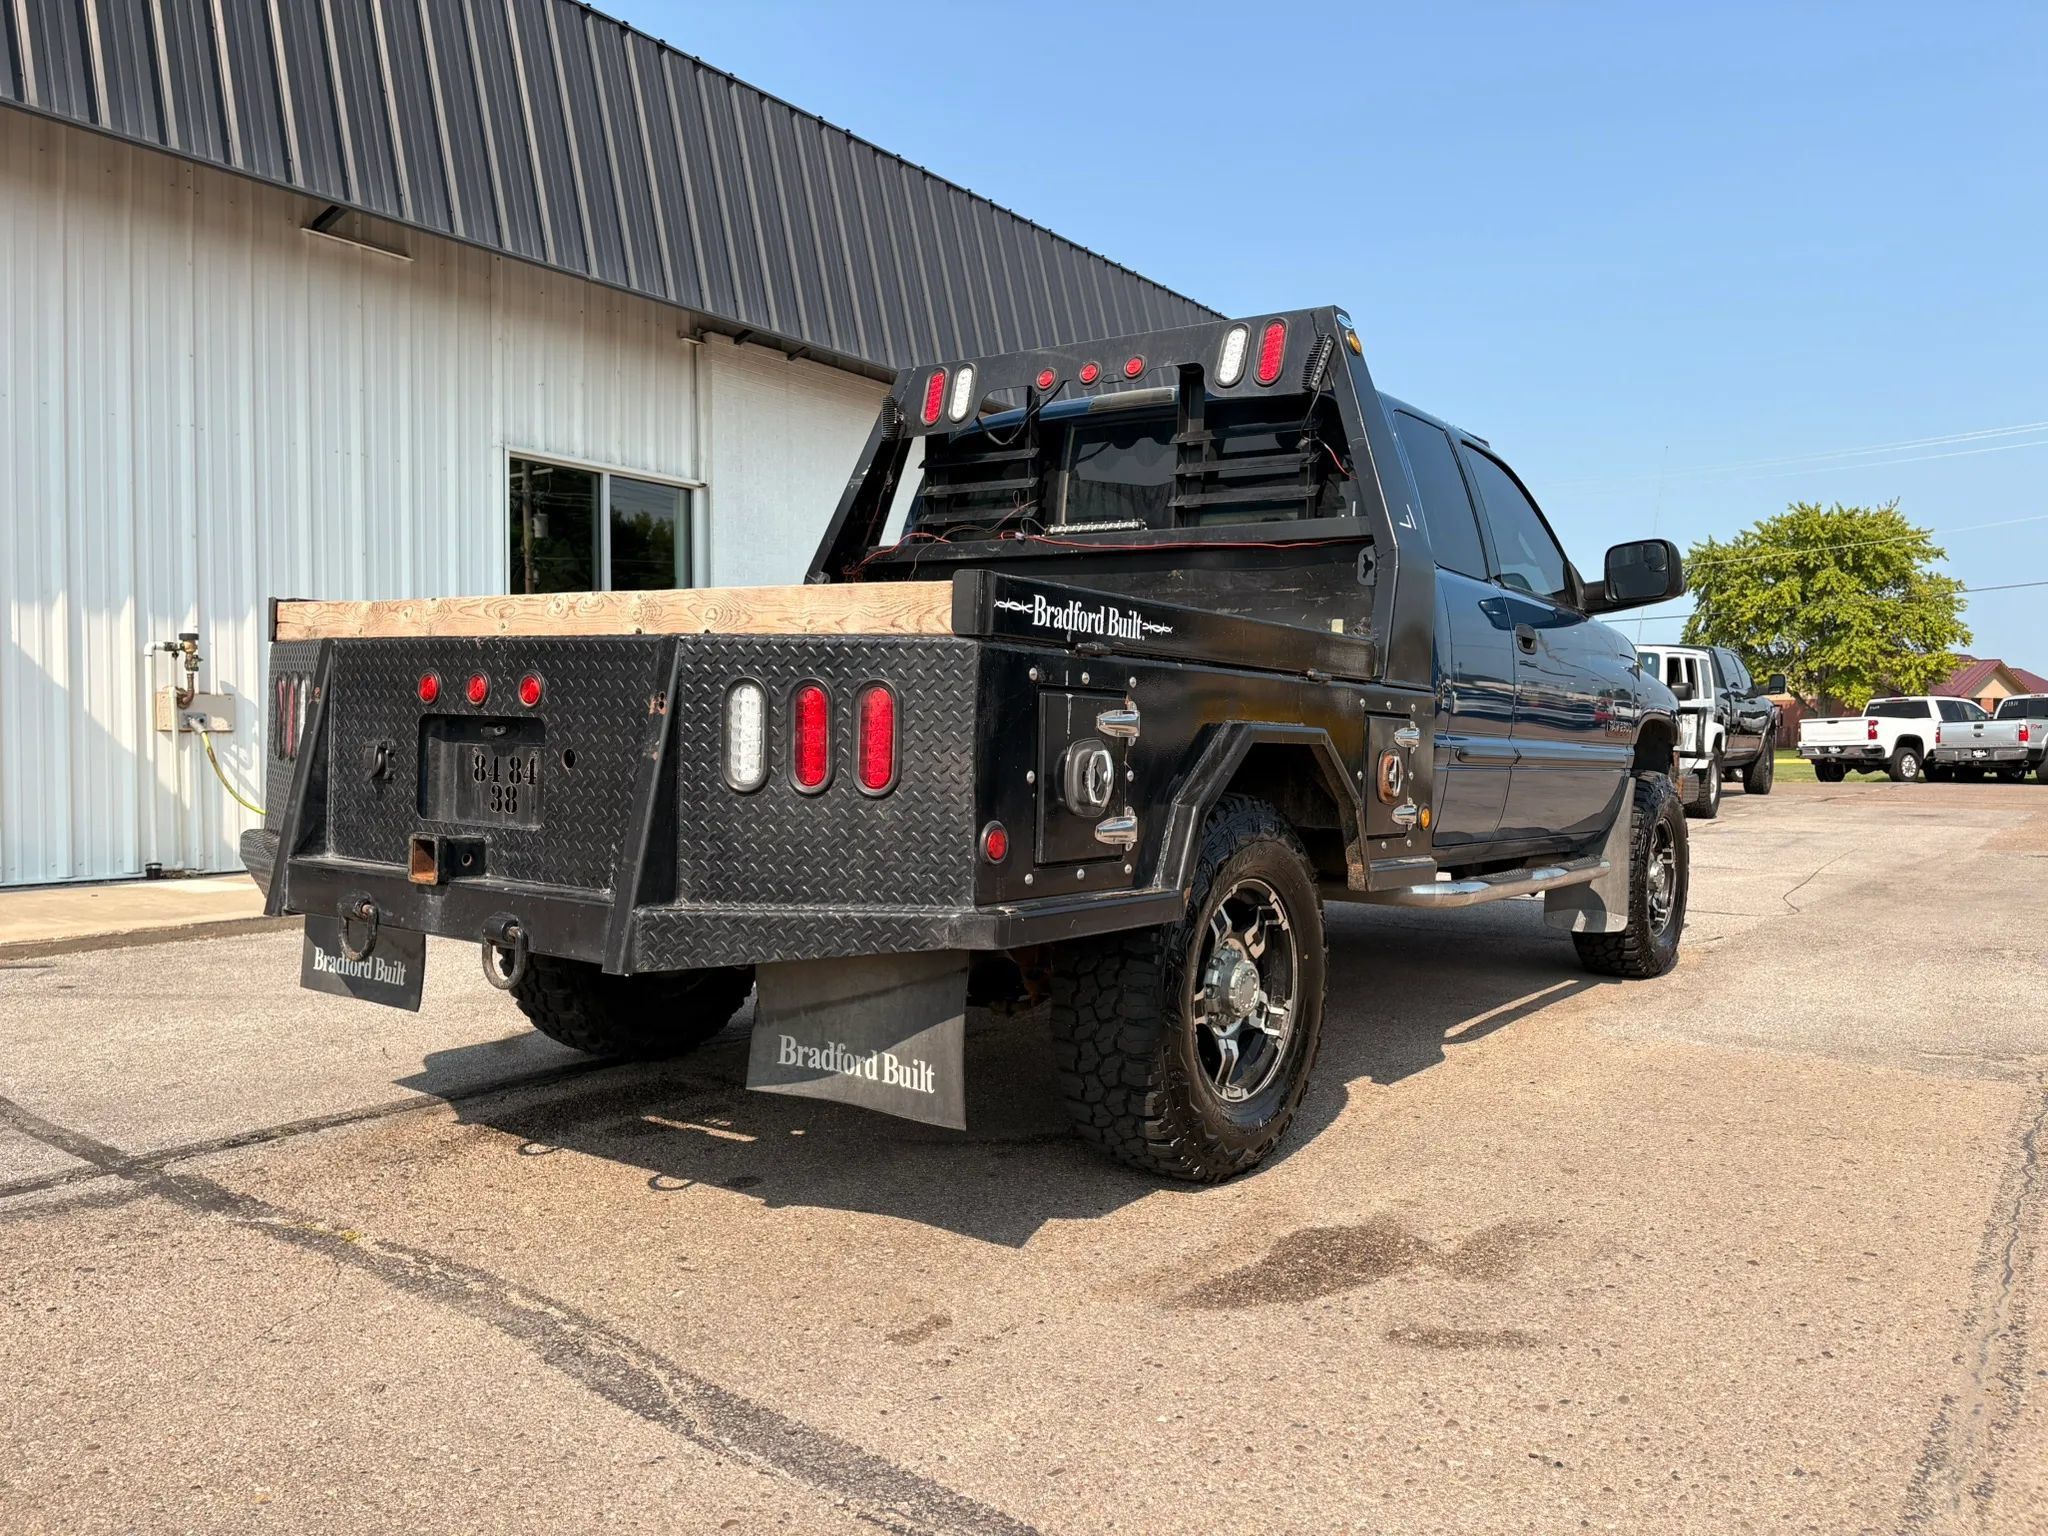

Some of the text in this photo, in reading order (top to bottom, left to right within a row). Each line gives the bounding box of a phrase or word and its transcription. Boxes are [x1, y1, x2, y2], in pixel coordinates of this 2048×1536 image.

[1032, 594, 1143, 640] Bradford Built
[473, 754, 537, 785] 84 84
[490, 784, 518, 814] 38
[374, 957, 407, 986] Built
[777, 1034, 936, 1094] Bradford Built
